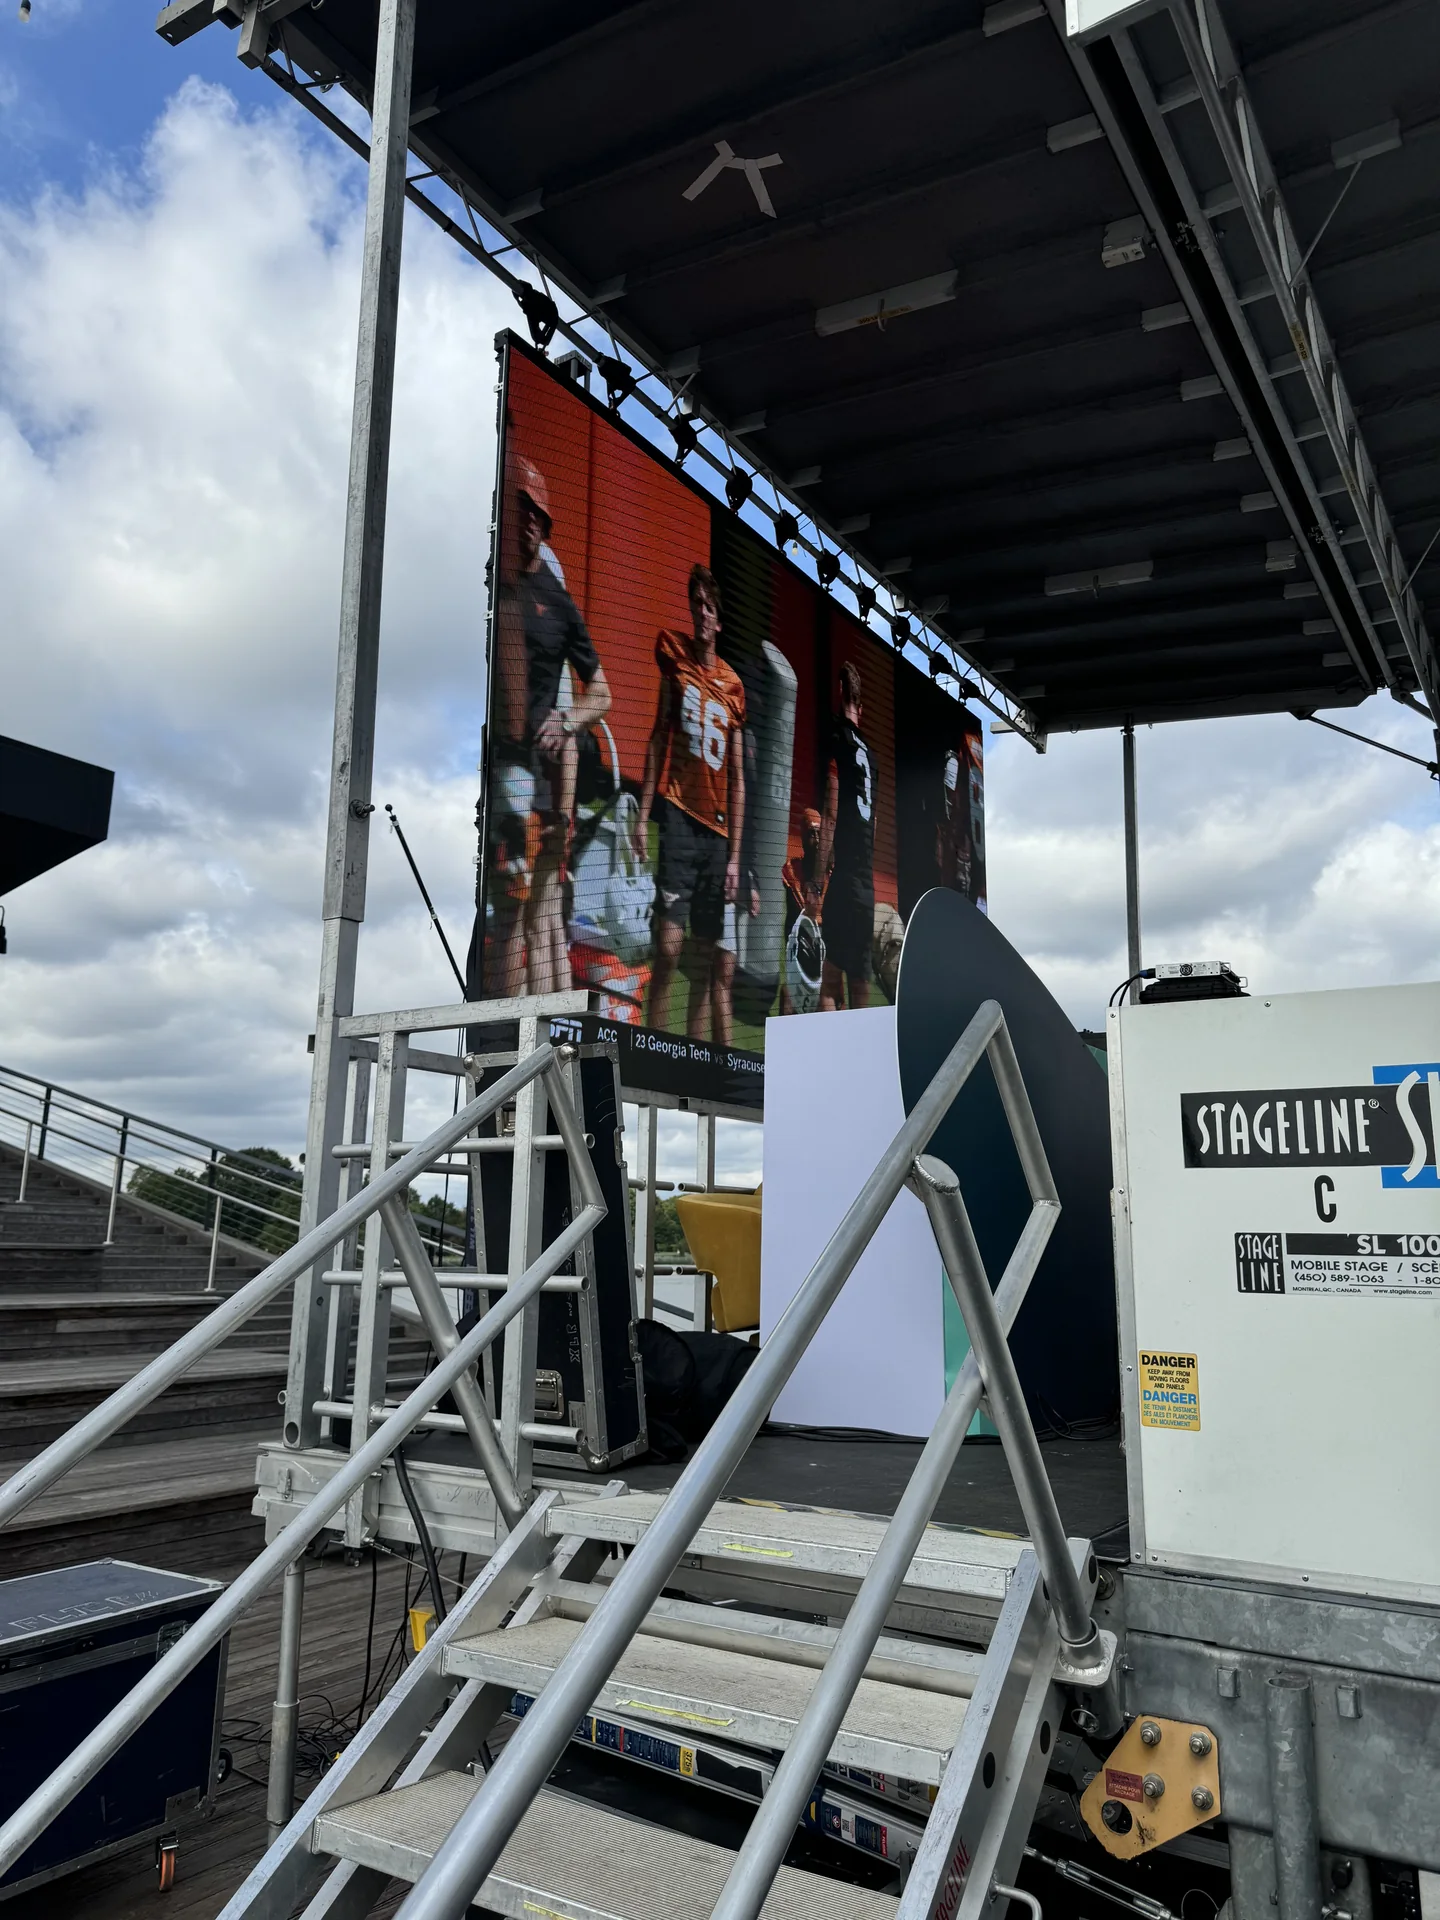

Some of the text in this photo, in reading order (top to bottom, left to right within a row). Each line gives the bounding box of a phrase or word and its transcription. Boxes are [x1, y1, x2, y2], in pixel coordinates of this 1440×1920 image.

[597, 1027, 618, 1043] ACC
[635, 1033, 646, 1049] 23
[647, 1035, 687, 1059] Georgia
[688, 1043, 711, 1063] Tech
[727, 1053, 766, 1073] Syracuse
[1313, 1174, 1338, 1224] C
[1238, 1234, 1279, 1260] STAGE
[1356, 1234, 1440, 1256] SL 100
[1290, 1260, 1440, 1274] MOBILE STAGE / SCÈ
[1239, 1261, 1281, 1292] LINE
[1294, 1272, 1327, 1283] (450)
[1330, 1274, 1385, 1284] 589-1063
[1373, 1288, 1433, 1296] www.stageline.com
[1141, 1354, 1196, 1369] DANGER
[1142, 1390, 1197, 1405] DANGER
[1172, 1406, 1198, 1414] DISTANCE
[1172, 1413, 1199, 1421] PLANCHERS
[1159, 1419, 1191, 1427] MOUVEMENT
